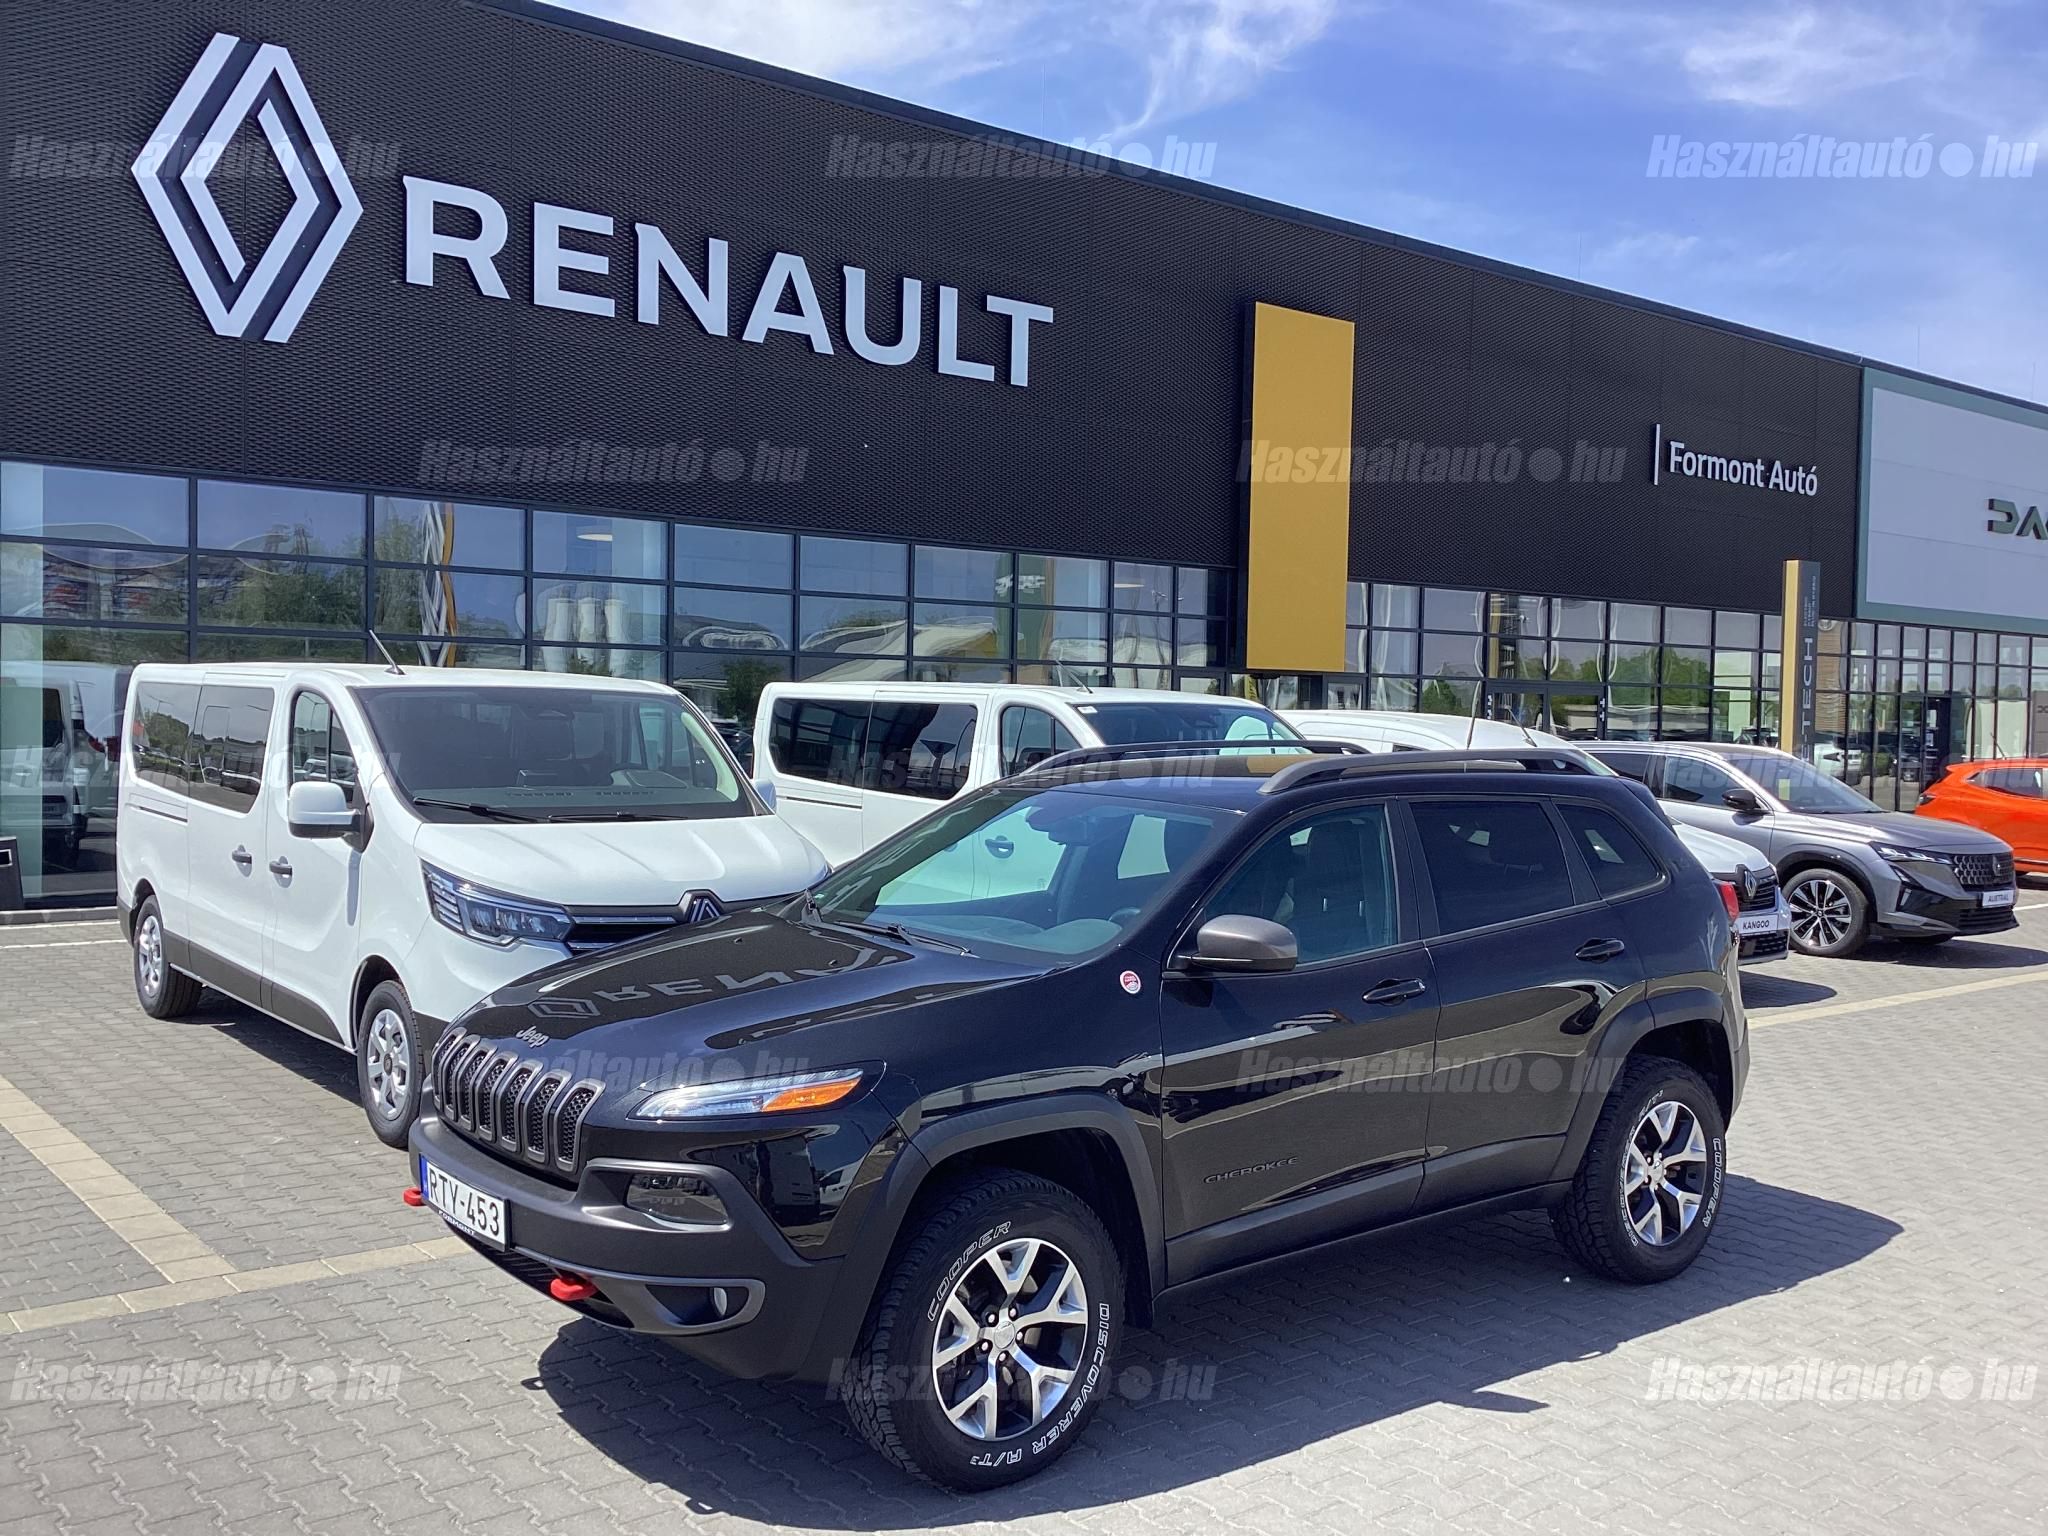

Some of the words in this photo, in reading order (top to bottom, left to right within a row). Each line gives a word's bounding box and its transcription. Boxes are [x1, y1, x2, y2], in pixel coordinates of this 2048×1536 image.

[403, 175, 1053, 387] RENAULT
[1670, 441, 1764, 487] Formont
[1769, 460, 1817, 496] Autó
[1988, 498, 2048, 540] DA
[1801, 638, 1813, 762] E-TECH
[1743, 919, 1770, 930] KANGOO
[515, 1025, 549, 1048] Jeep
[428, 1167, 500, 1237] RTY-453
[1203, 1156, 1298, 1184] CHEROKEE
[1702, 1137, 1724, 1228] COOPER
[927, 1220, 1012, 1322] COOPER
[1031, 1302, 1111, 1455] DISCOVERER
